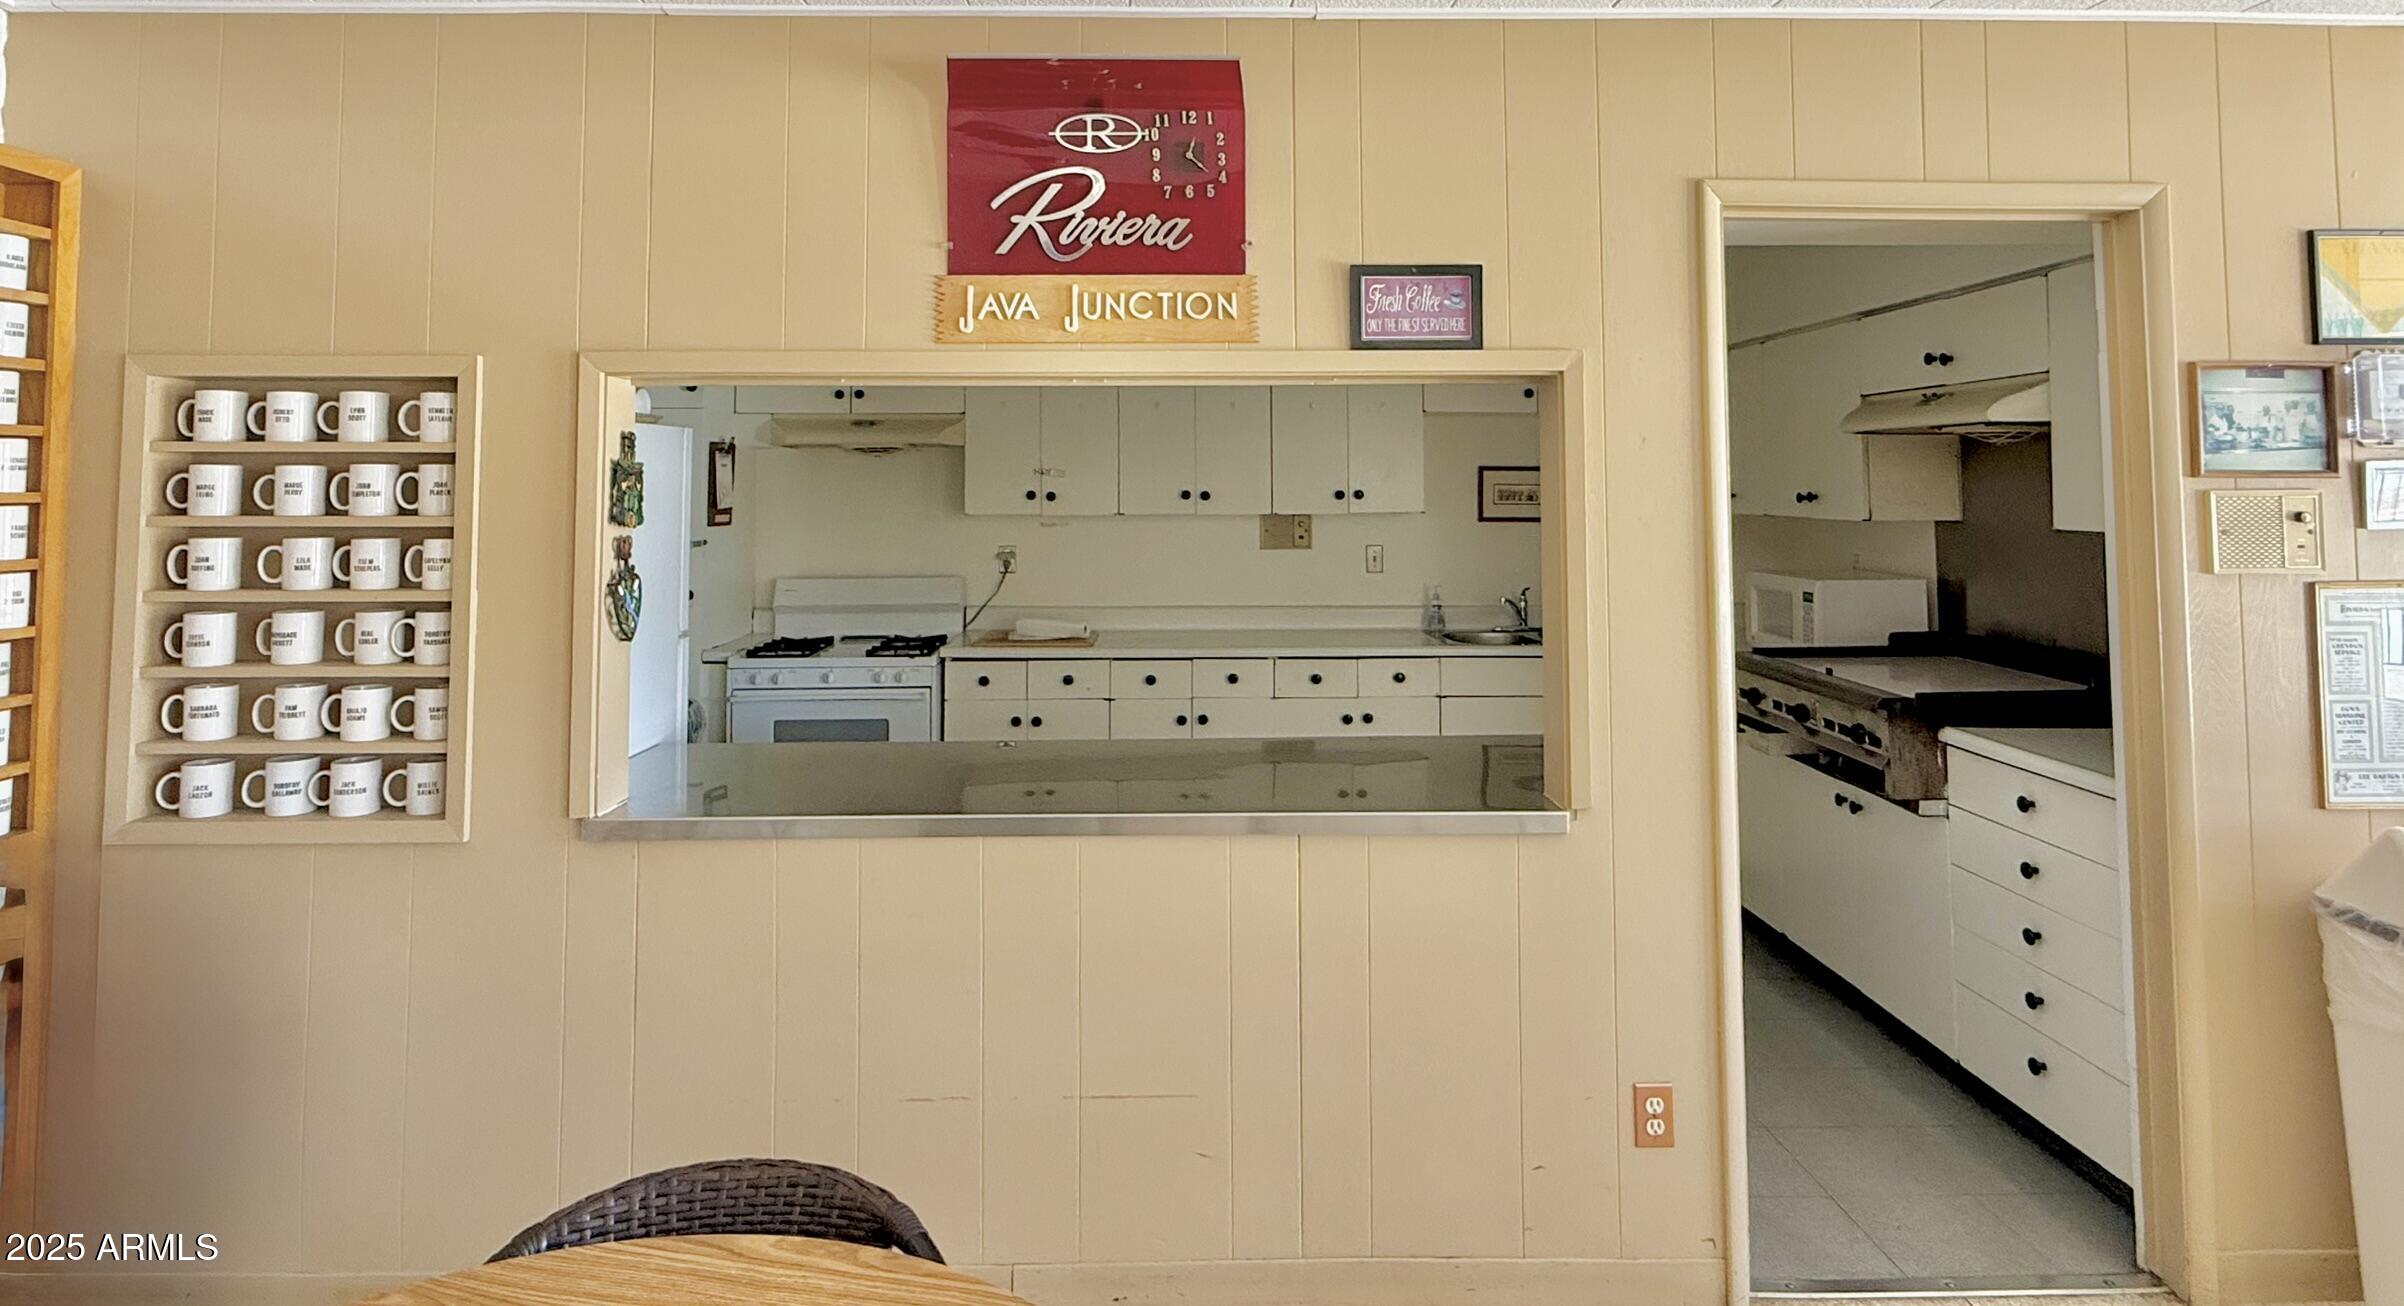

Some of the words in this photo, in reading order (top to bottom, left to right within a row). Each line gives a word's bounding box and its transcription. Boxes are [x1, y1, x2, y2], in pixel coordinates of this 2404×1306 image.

[1154, 113, 1170, 128] 11
[1181, 110, 1197, 125] 12
[1206, 111, 1213, 125] 1
[1143, 127, 1160, 142] 10
[1216, 131, 1225, 146] 2
[1151, 147, 1161, 162] 9
[1217, 152, 1226, 167] 3
[1151, 167, 1161, 183] 8
[1218, 169, 1228, 184] 4
[1163, 185, 1173, 199] 7
[1185, 184, 1195, 199] 6
[1206, 183, 1216, 198] 5
[990, 166, 1193, 262] Riviera
[1366, 284, 1403, 314] Fresh
[1405, 284, 1441, 313] Coffee
[959, 285, 1040, 333] JAVA
[1064, 284, 1238, 333] JUNCTION
[1366, 317, 1382, 333] ONLY
[1383, 317, 1398, 333] THE
[1398, 317, 1420, 333] FINEST
[1420, 317, 1449, 333] SERVED
